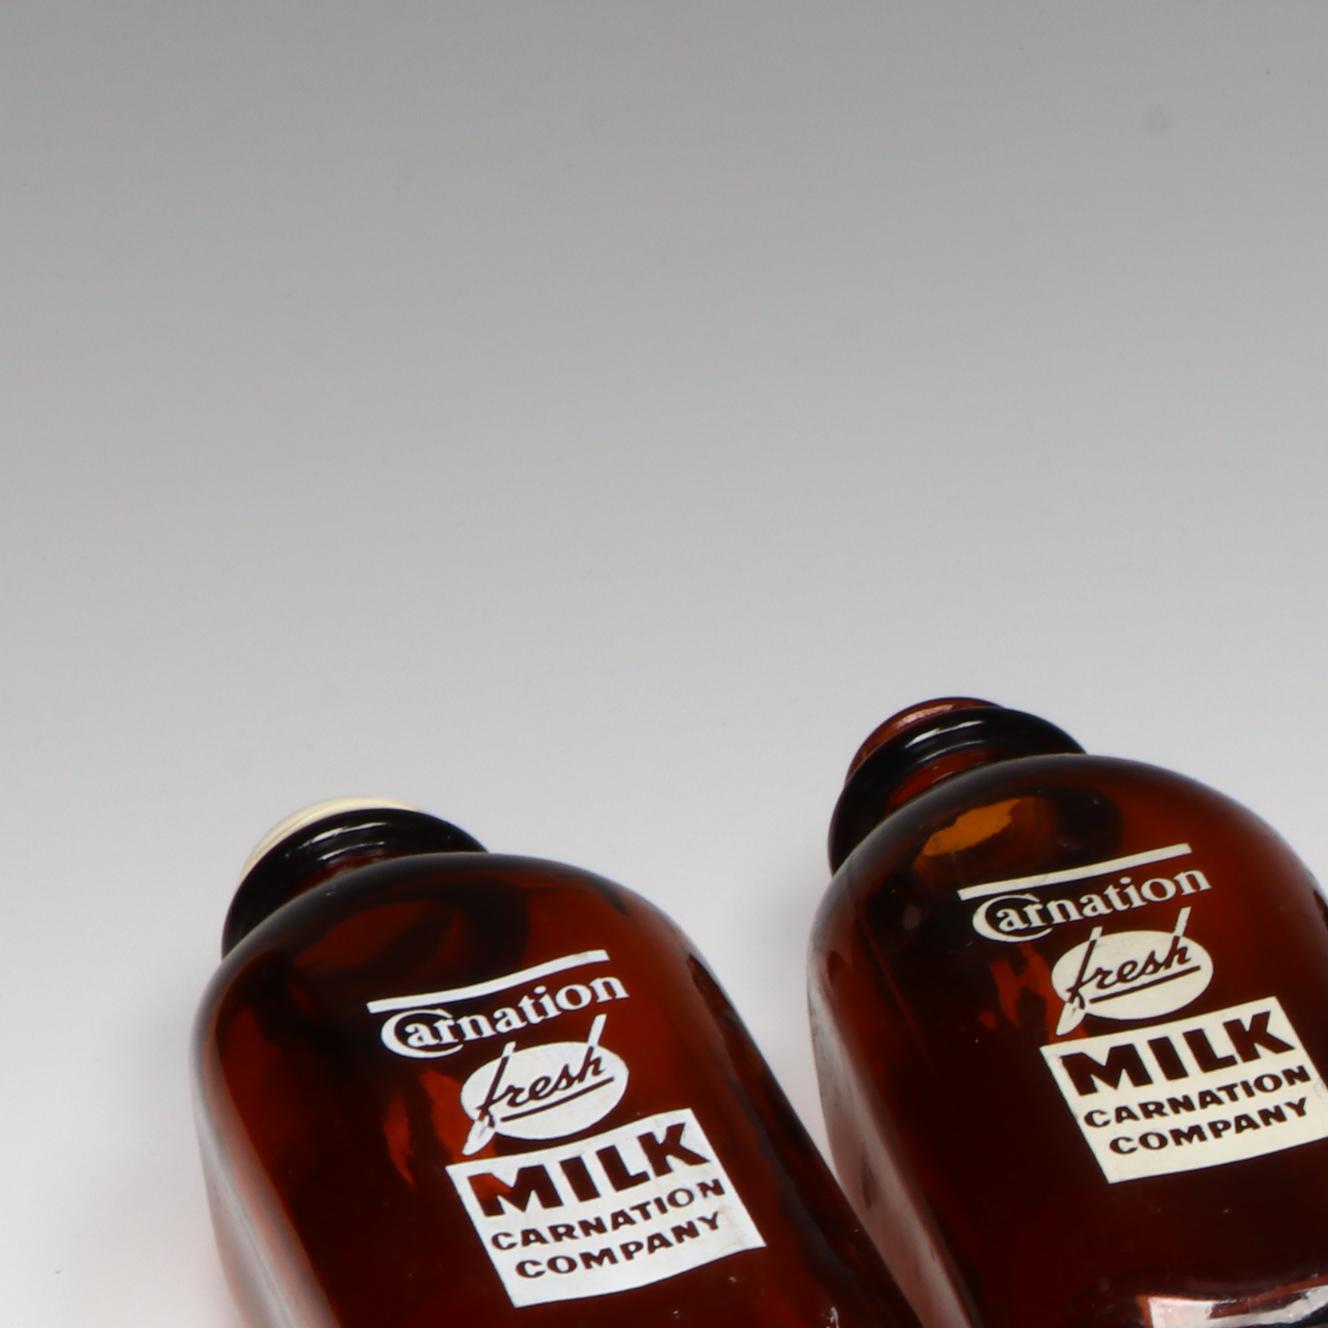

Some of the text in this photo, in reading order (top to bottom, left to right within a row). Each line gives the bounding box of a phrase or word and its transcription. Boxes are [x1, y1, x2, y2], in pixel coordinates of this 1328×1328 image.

[972, 868, 1212, 943] Carnation
[1056, 907, 1191, 1036] fresh
[380, 975, 630, 1059] Carnation
[1060, 1010, 1296, 1097] MILK
[462, 1014, 607, 1156] fresh
[1084, 1066, 1312, 1128] CARNATION
[1108, 1097, 1308, 1155] COMPANY
[466, 1122, 710, 1218] MILK
[491, 1178, 725, 1250] CARNATION
[515, 1212, 720, 1279] COMPANY
